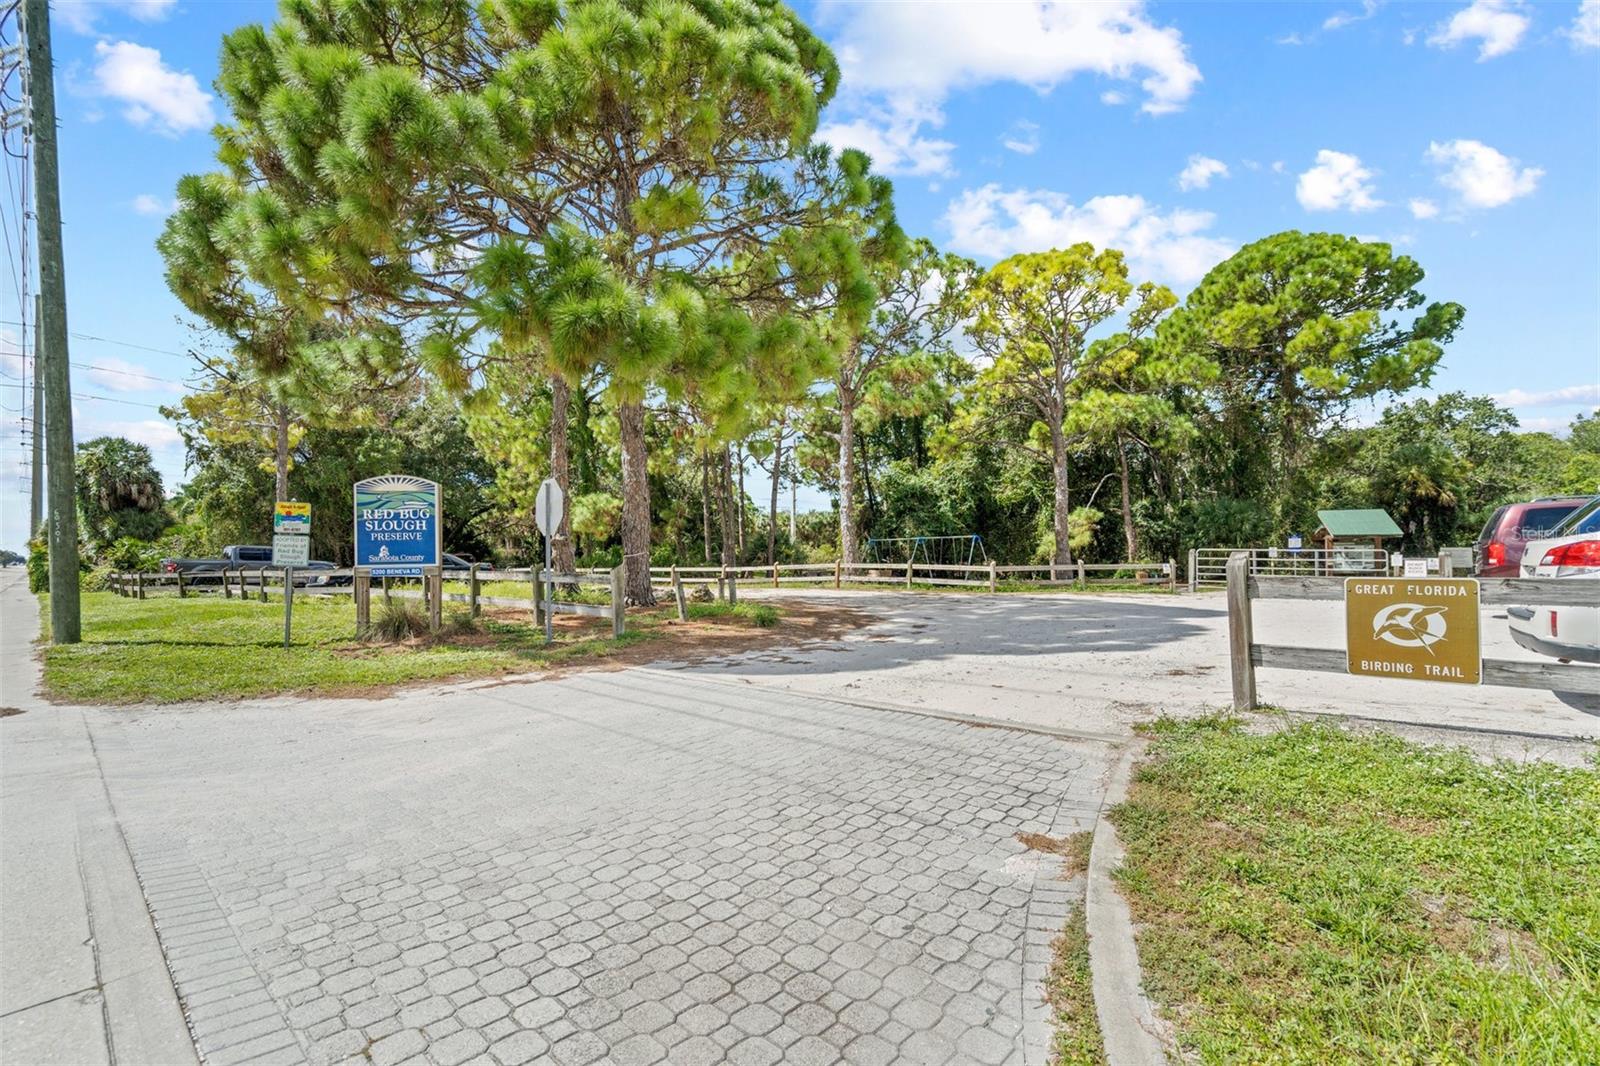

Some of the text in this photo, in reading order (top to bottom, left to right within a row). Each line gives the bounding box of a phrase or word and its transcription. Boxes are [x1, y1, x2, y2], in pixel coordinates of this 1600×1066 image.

[363, 509, 430, 519] RED BUG
[365, 520, 427, 531] SLOUGH
[371, 533, 423, 541] PRESERVE
[400, 554, 424, 562] County
[1355, 584, 1467, 597] GREAT FLORIDA
[1361, 660, 1465, 678] BIRDING TRAIL
